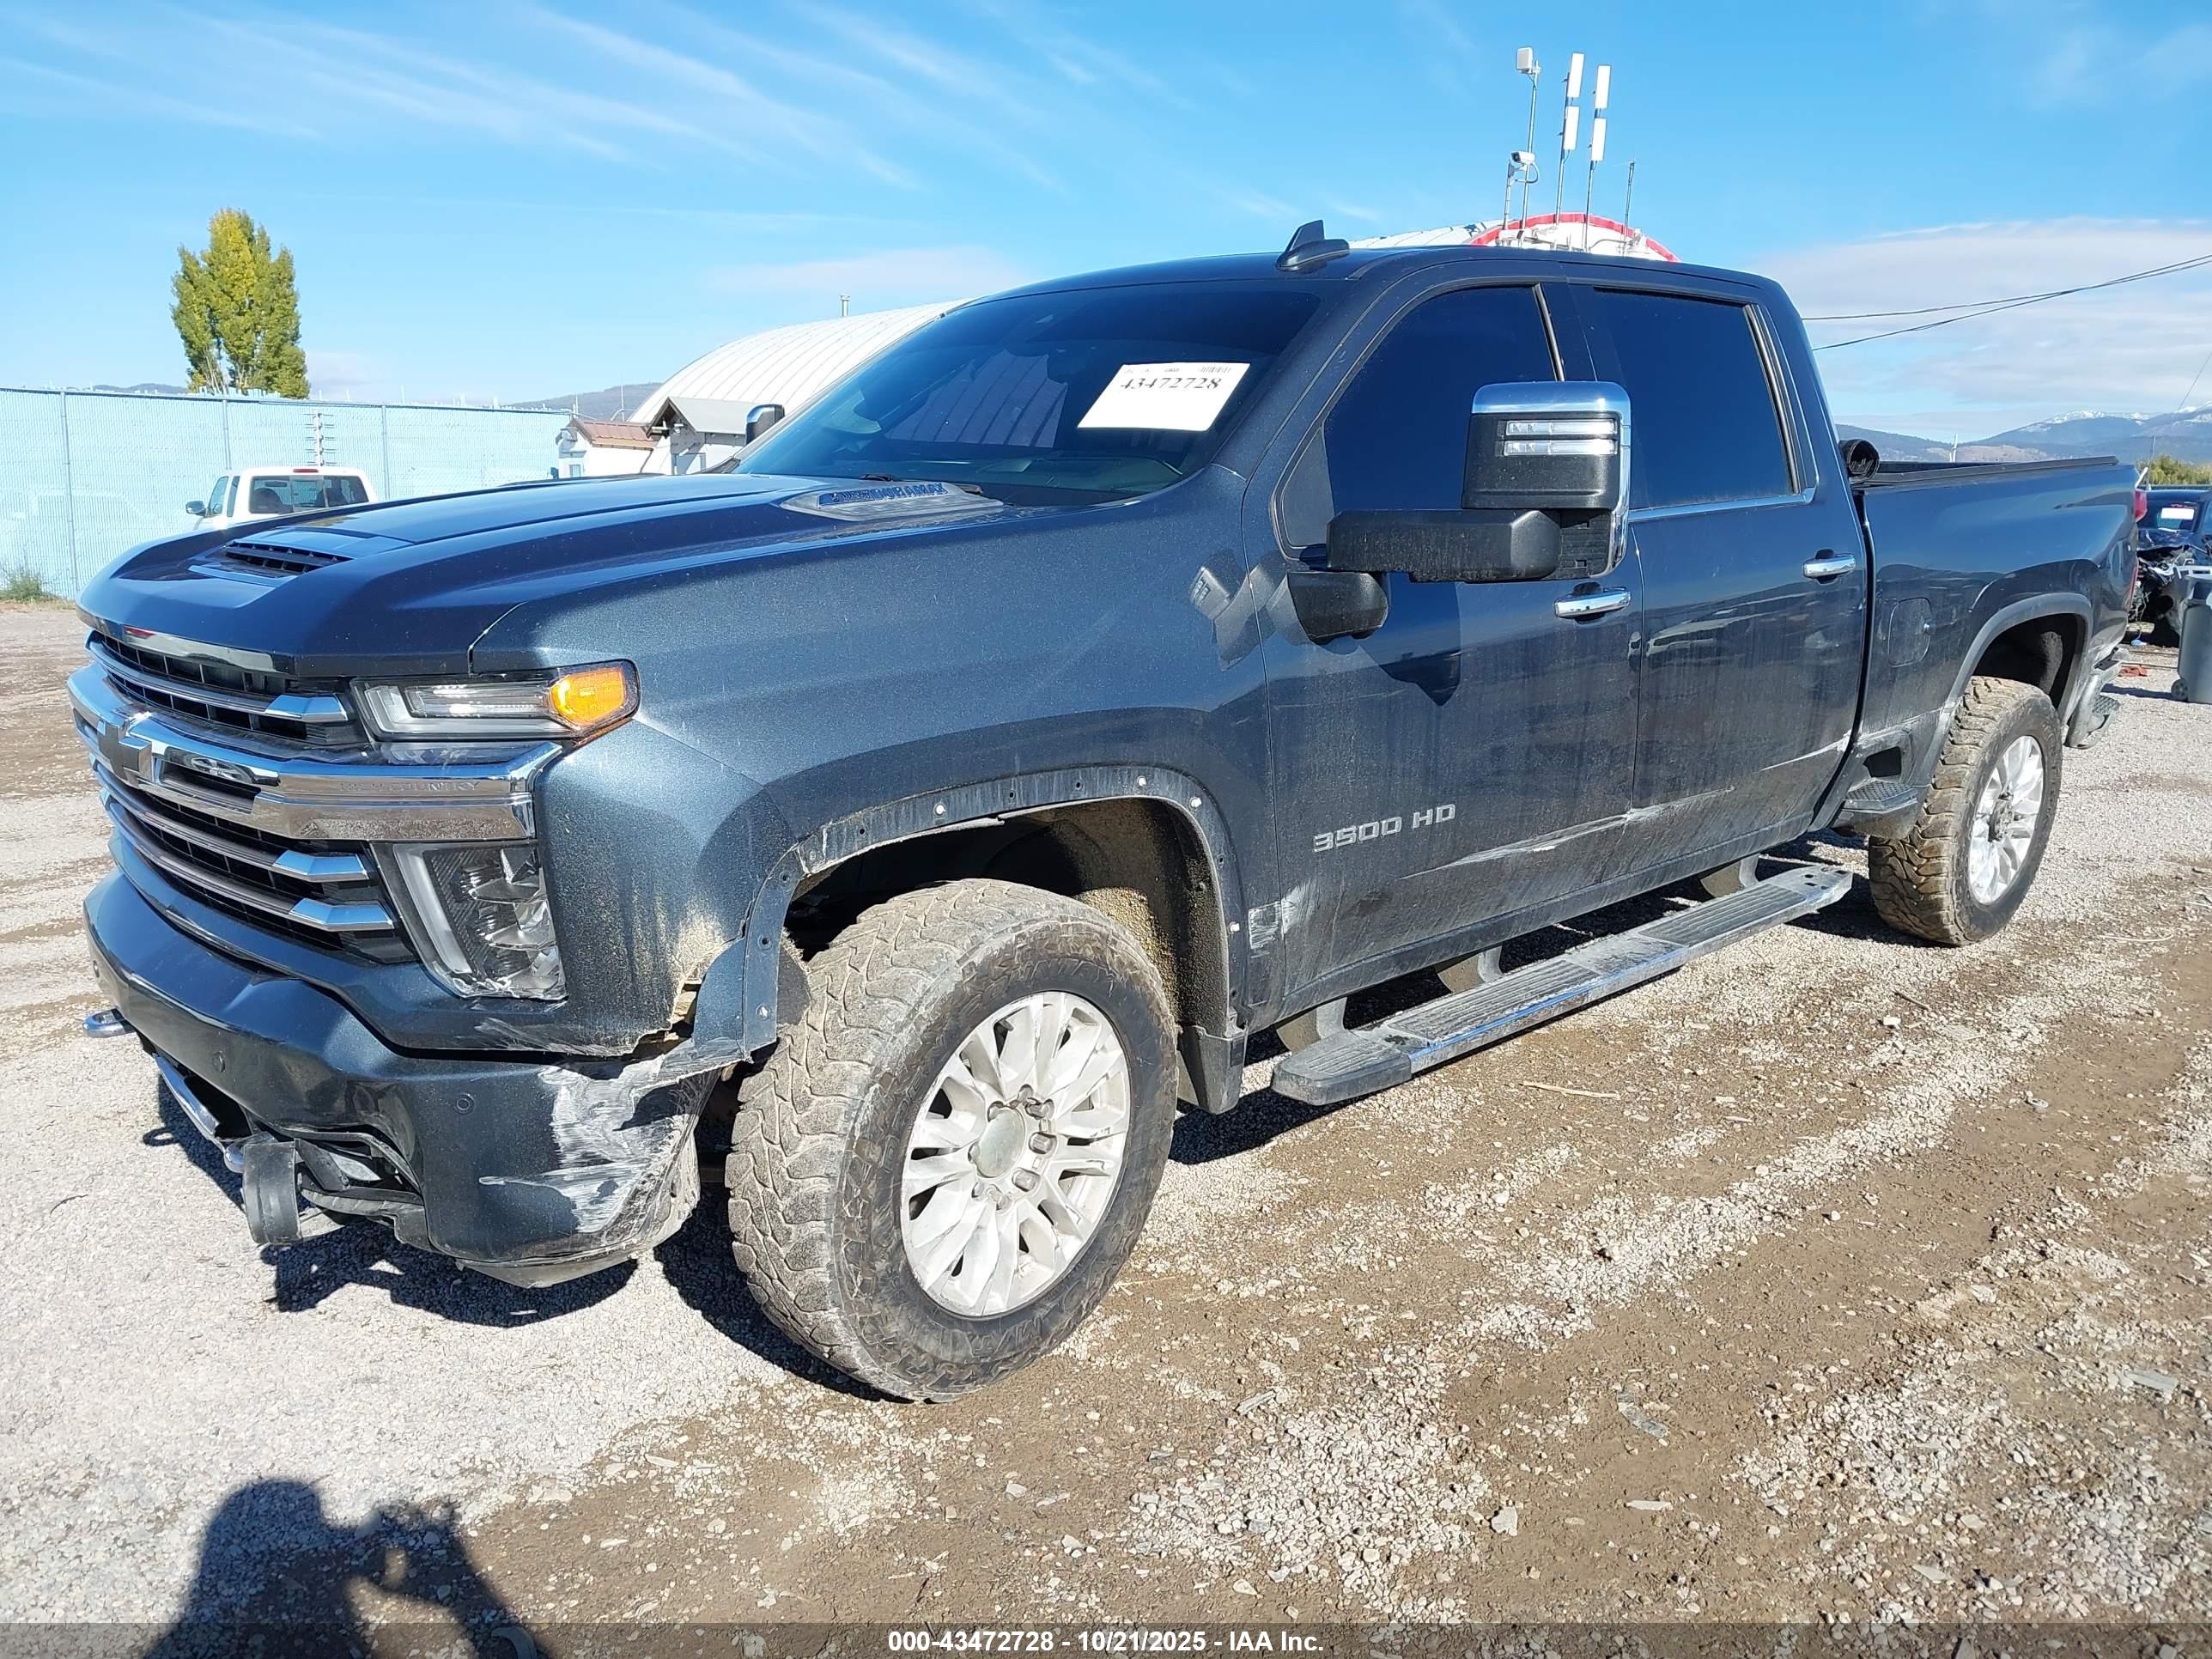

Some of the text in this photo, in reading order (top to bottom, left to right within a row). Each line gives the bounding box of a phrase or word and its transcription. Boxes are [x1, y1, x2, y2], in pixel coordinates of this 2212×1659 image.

[1120, 377, 1222, 389] 43472728
[1313, 803, 1456, 854] 3500 HD
